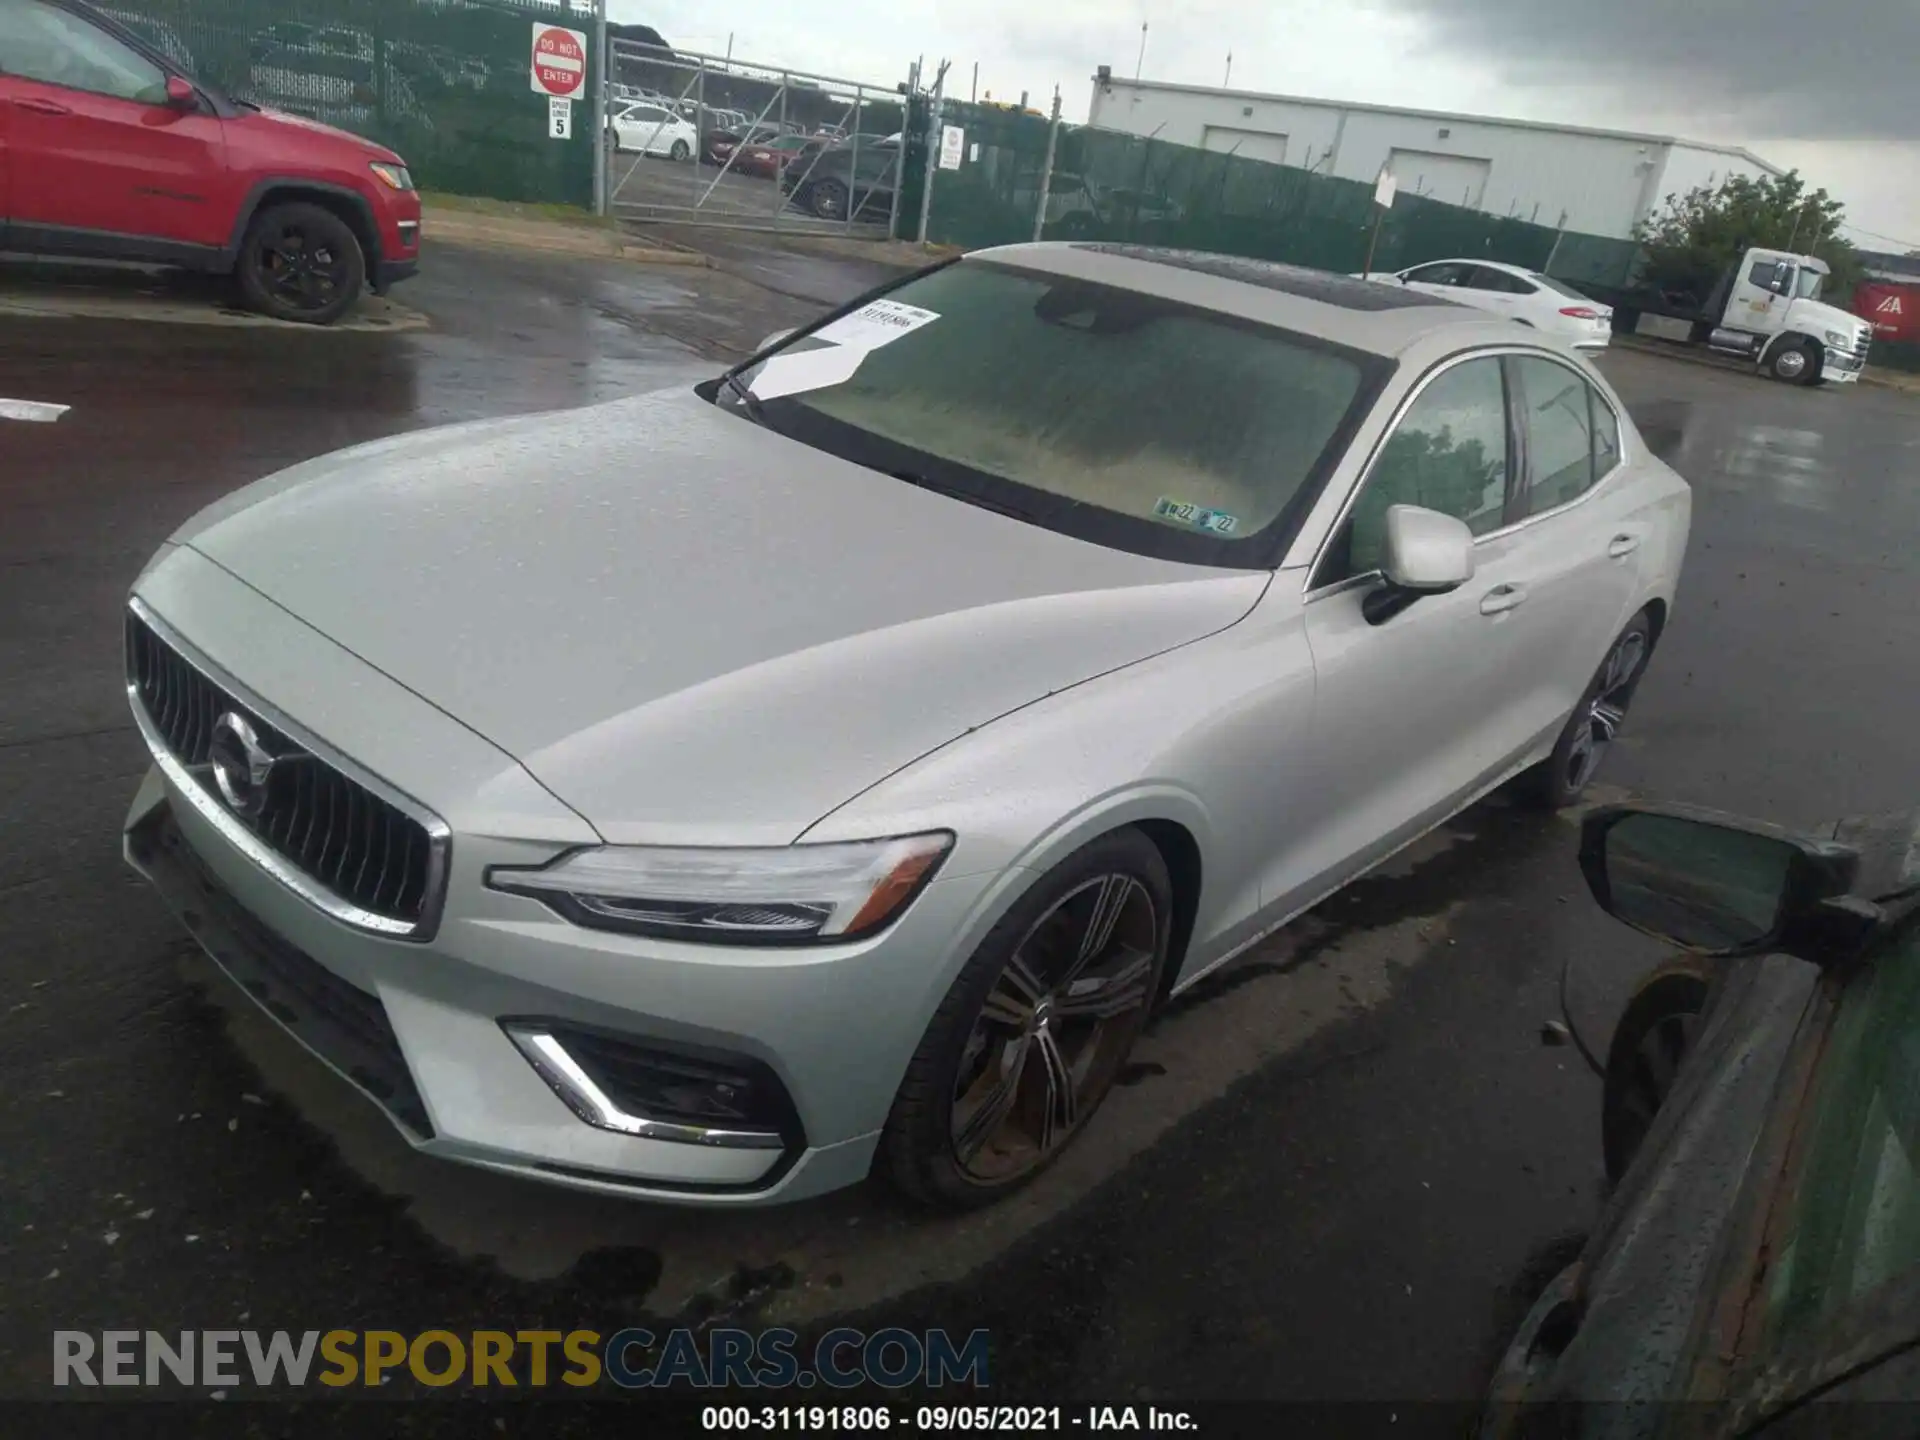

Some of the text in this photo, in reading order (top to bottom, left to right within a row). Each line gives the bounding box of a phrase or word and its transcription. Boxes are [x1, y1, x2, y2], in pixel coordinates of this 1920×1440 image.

[541, 39, 578, 56] DO NOT
[543, 69, 574, 84] ENTER
[555, 119, 565, 135] 5
